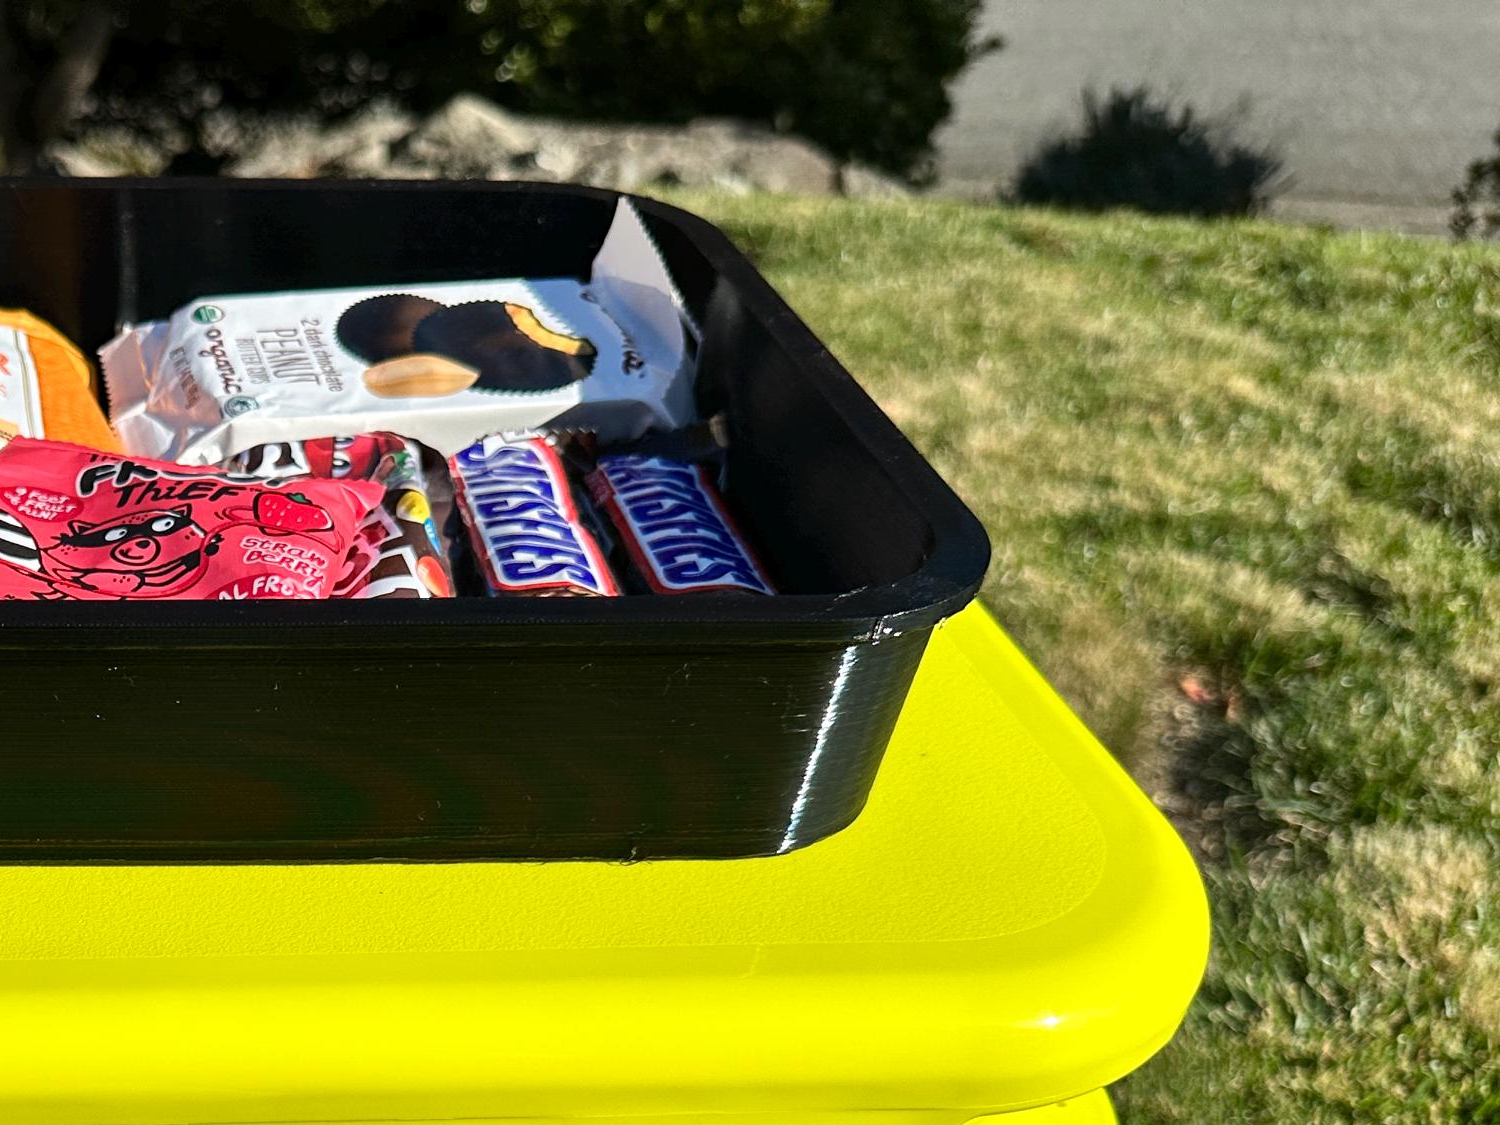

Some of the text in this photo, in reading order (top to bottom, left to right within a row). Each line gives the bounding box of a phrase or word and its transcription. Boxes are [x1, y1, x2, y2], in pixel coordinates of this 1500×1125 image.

[200, 328, 242, 395] organic
[256, 328, 321, 387] PEANUT
[457, 441, 599, 590] SATISFIES
